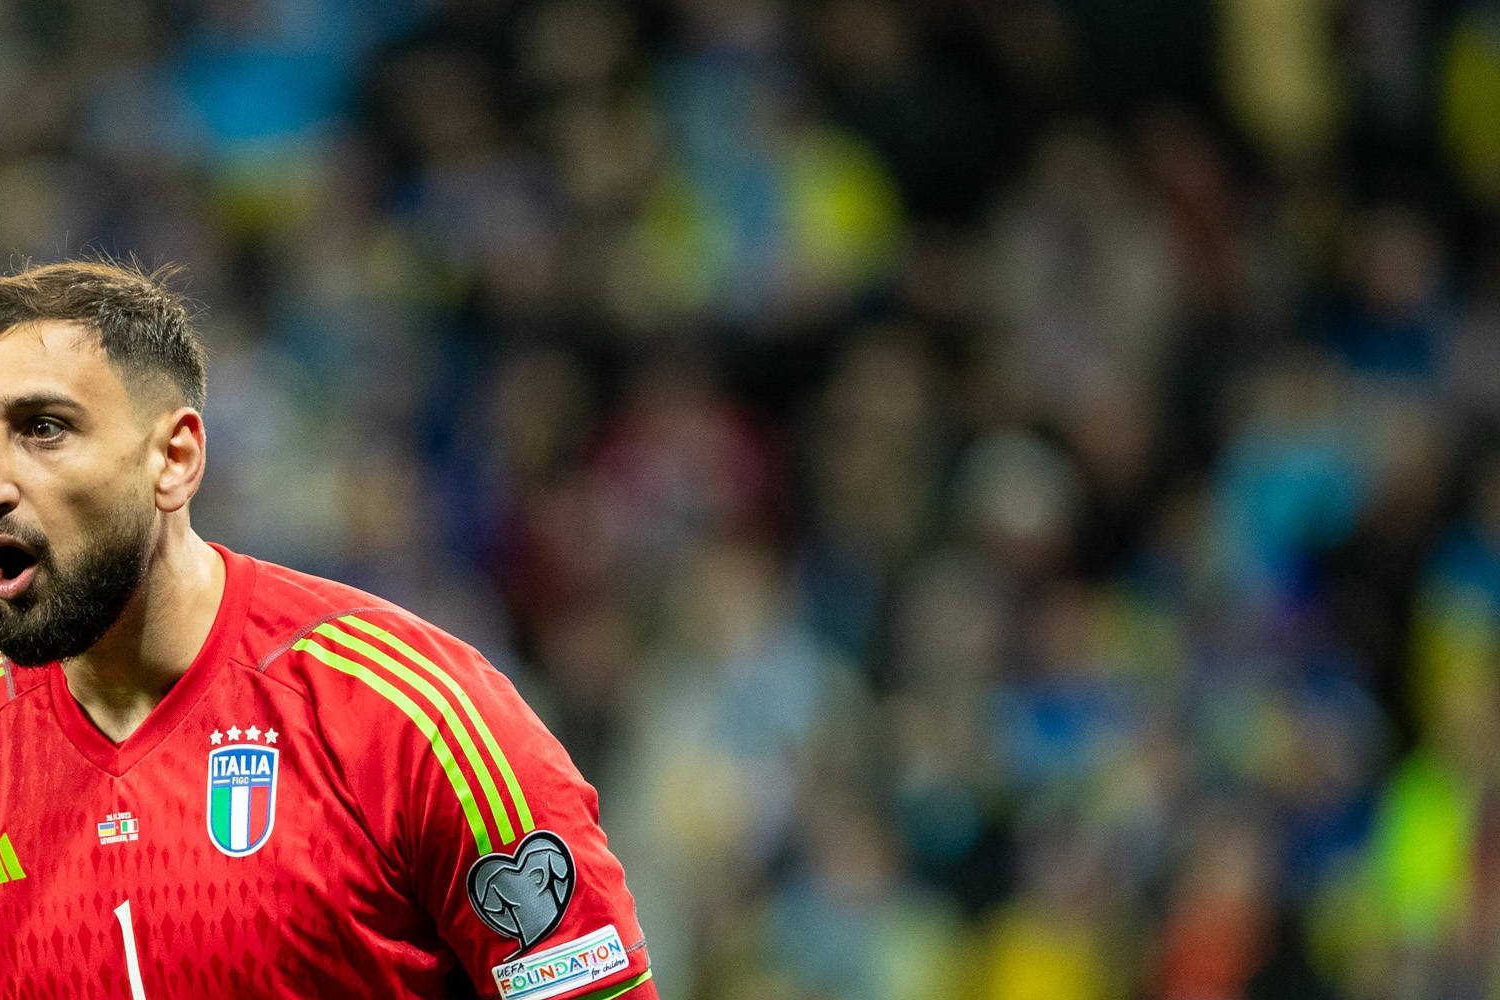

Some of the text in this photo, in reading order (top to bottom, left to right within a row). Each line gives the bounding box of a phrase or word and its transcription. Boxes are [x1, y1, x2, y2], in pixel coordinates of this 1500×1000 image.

[213, 755, 271, 777] ITALIA
[231, 776, 250, 785] FIGC
[496, 961, 525, 979] UEFA
[591, 957, 626, 980] for children
